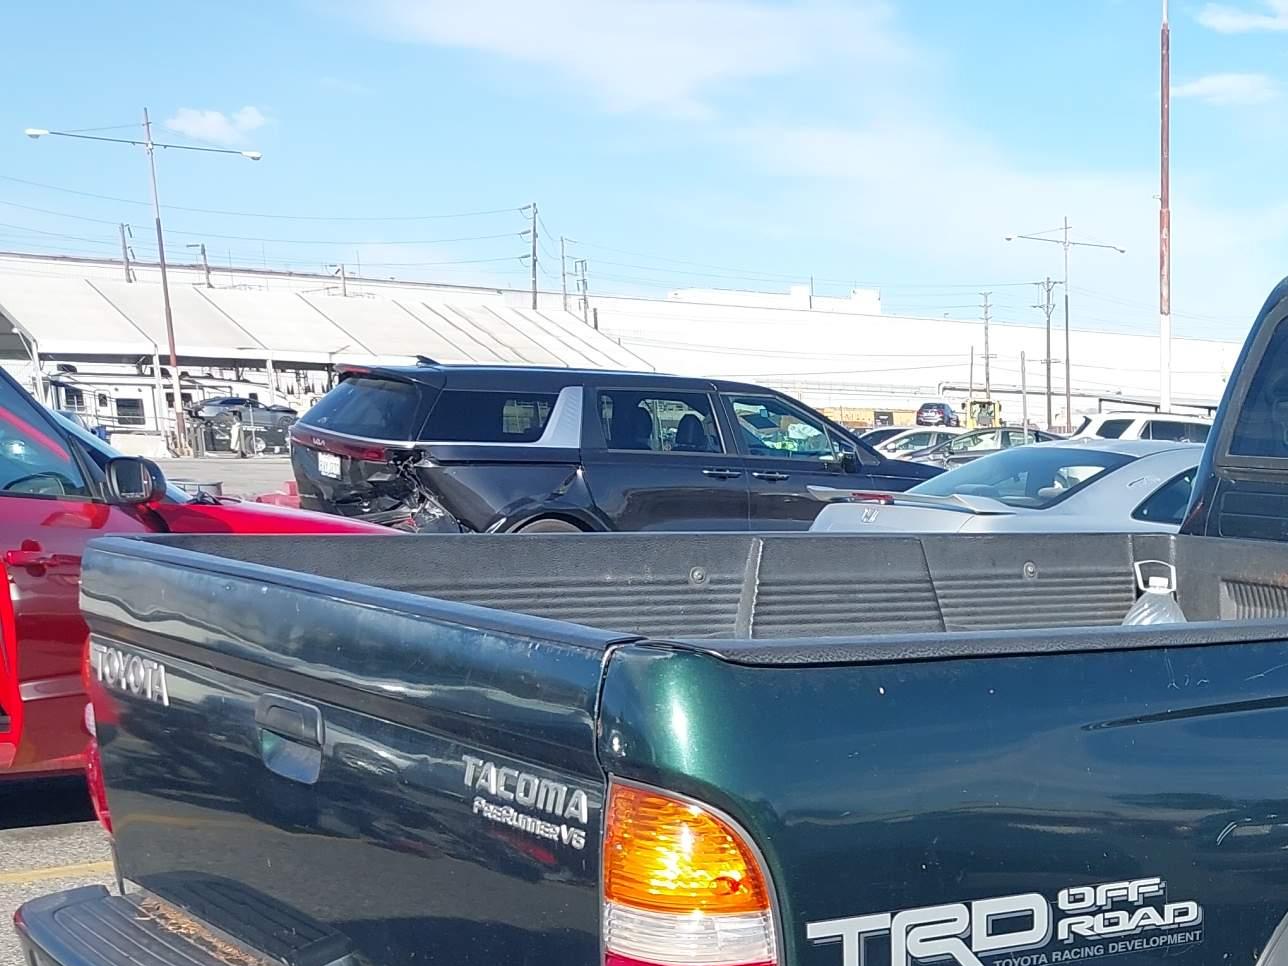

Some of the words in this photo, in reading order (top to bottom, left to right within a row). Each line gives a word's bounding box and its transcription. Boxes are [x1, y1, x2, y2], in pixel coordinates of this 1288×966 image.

[95, 646, 169, 706] TOYOTA
[462, 755, 588, 824] TACOMA
[560, 824, 586, 850] V6
[1057, 877, 1166, 911] OFF
[1057, 901, 1204, 943] ROAD
[1052, 945, 1104, 962] RACING
[1109, 930, 1202, 953] DEVELOPMENT
